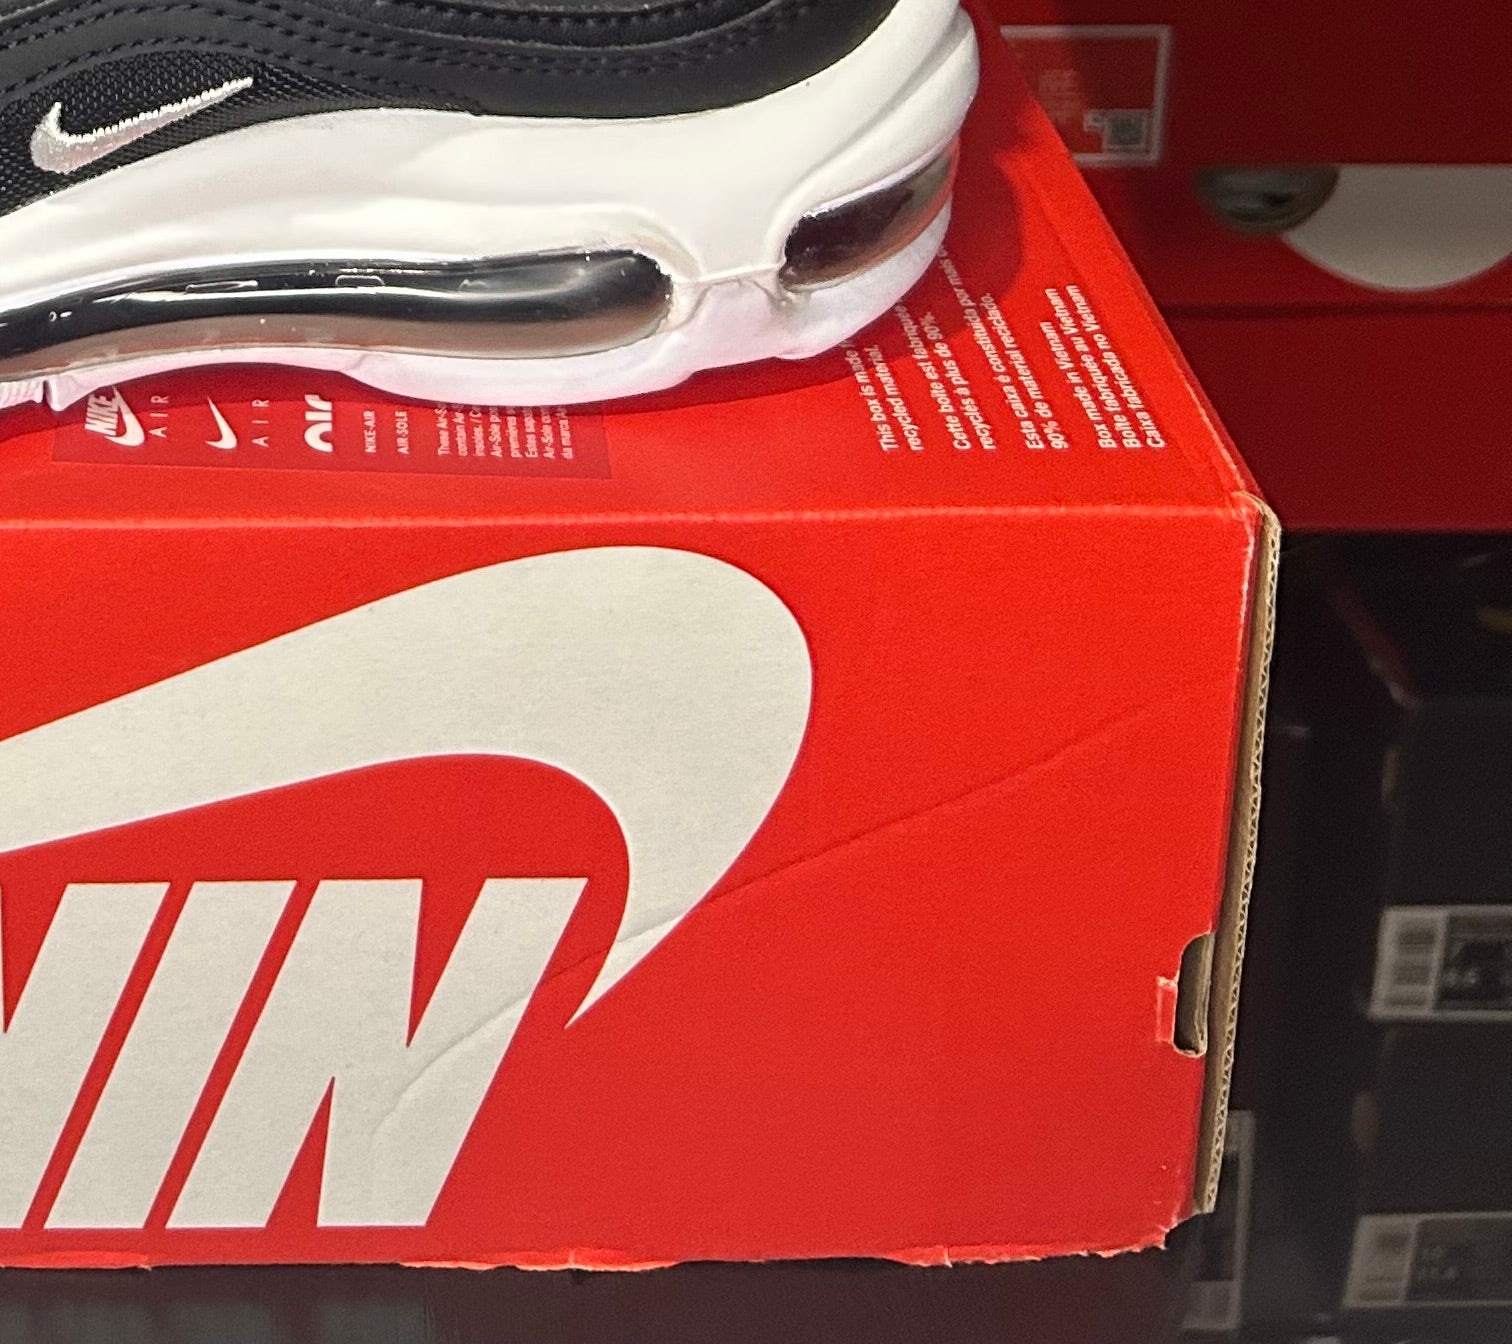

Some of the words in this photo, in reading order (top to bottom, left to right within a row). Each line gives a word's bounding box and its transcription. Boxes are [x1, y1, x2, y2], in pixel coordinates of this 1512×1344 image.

[953, 288, 976, 306] por
[1045, 288, 1079, 335] Vietnam
[1066, 285, 1100, 332] Vietnam
[981, 296, 1017, 348] reciclado.
[934, 342, 951, 357] de
[1040, 322, 1074, 370] Vietnam
[1071, 337, 1089, 352] au
[1093, 334, 1111, 349] no
[845, 351, 870, 383] made
[865, 348, 899, 395] material.
[917, 361, 939, 380] est
[942, 360, 969, 385] plus
[1005, 350, 1043, 399] material
[1067, 372, 1082, 383] in
[1081, 354, 1121, 412] fabriquée
[1102, 352, 1144, 409] fabricada
[859, 385, 876, 396] is
[1003, 385, 1028, 418] caixa
[1073, 386, 1103, 421] made
[85, 393, 119, 437] NIKE
[149, 395, 169, 439] AIR
[252, 399, 270, 448] AIR
[867, 399, 886, 421] box
[886, 398, 924, 450] recycled
[961, 398, 996, 449] recyclés
[1034, 402, 1052, 418] de
[877, 424, 898, 451] This
[946, 415, 971, 450] Cette
[1020, 421, 1045, 449] Esta
[1042, 421, 1068, 449] 90%
[1094, 424, 1117, 448] Box
[1136, 412, 1165, 448] Caixa
